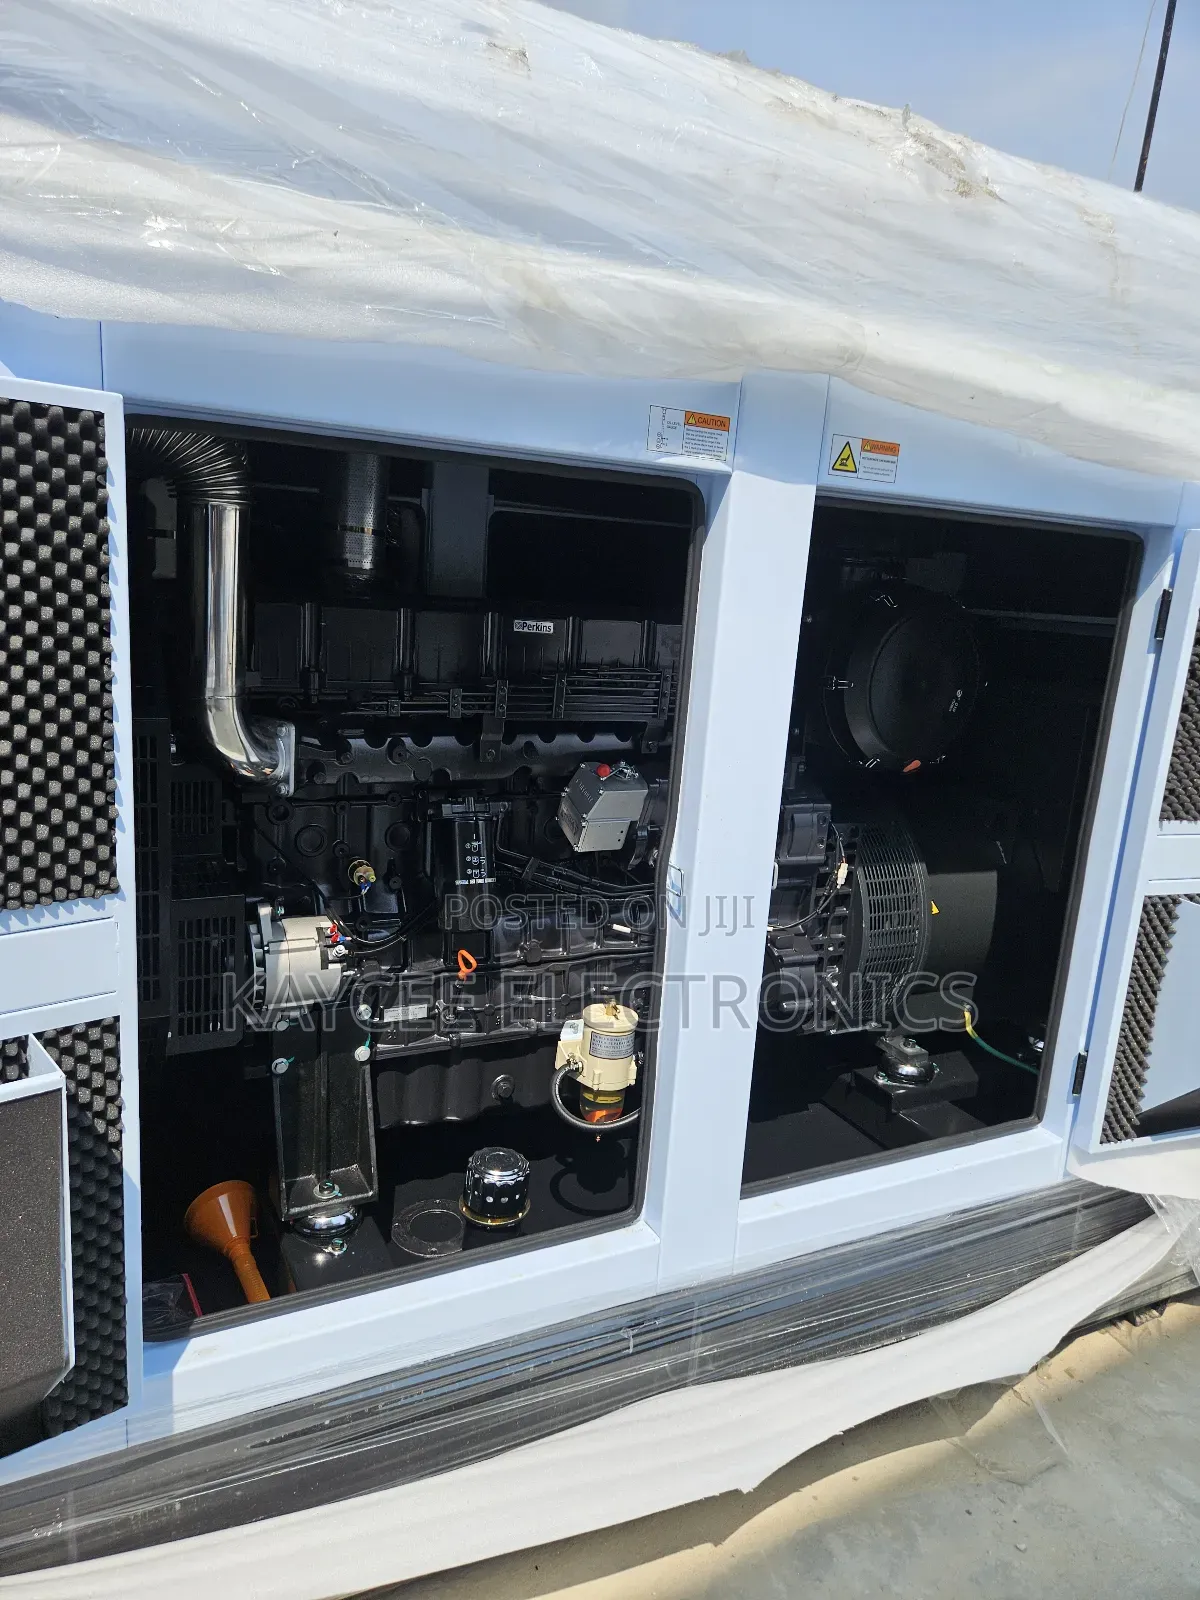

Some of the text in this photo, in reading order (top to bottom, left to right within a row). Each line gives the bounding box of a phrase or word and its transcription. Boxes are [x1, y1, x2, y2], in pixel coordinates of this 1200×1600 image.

[697, 416, 726, 428] CAUTION
[871, 443, 897, 453] WARNING
[522, 621, 552, 632] Perkins
